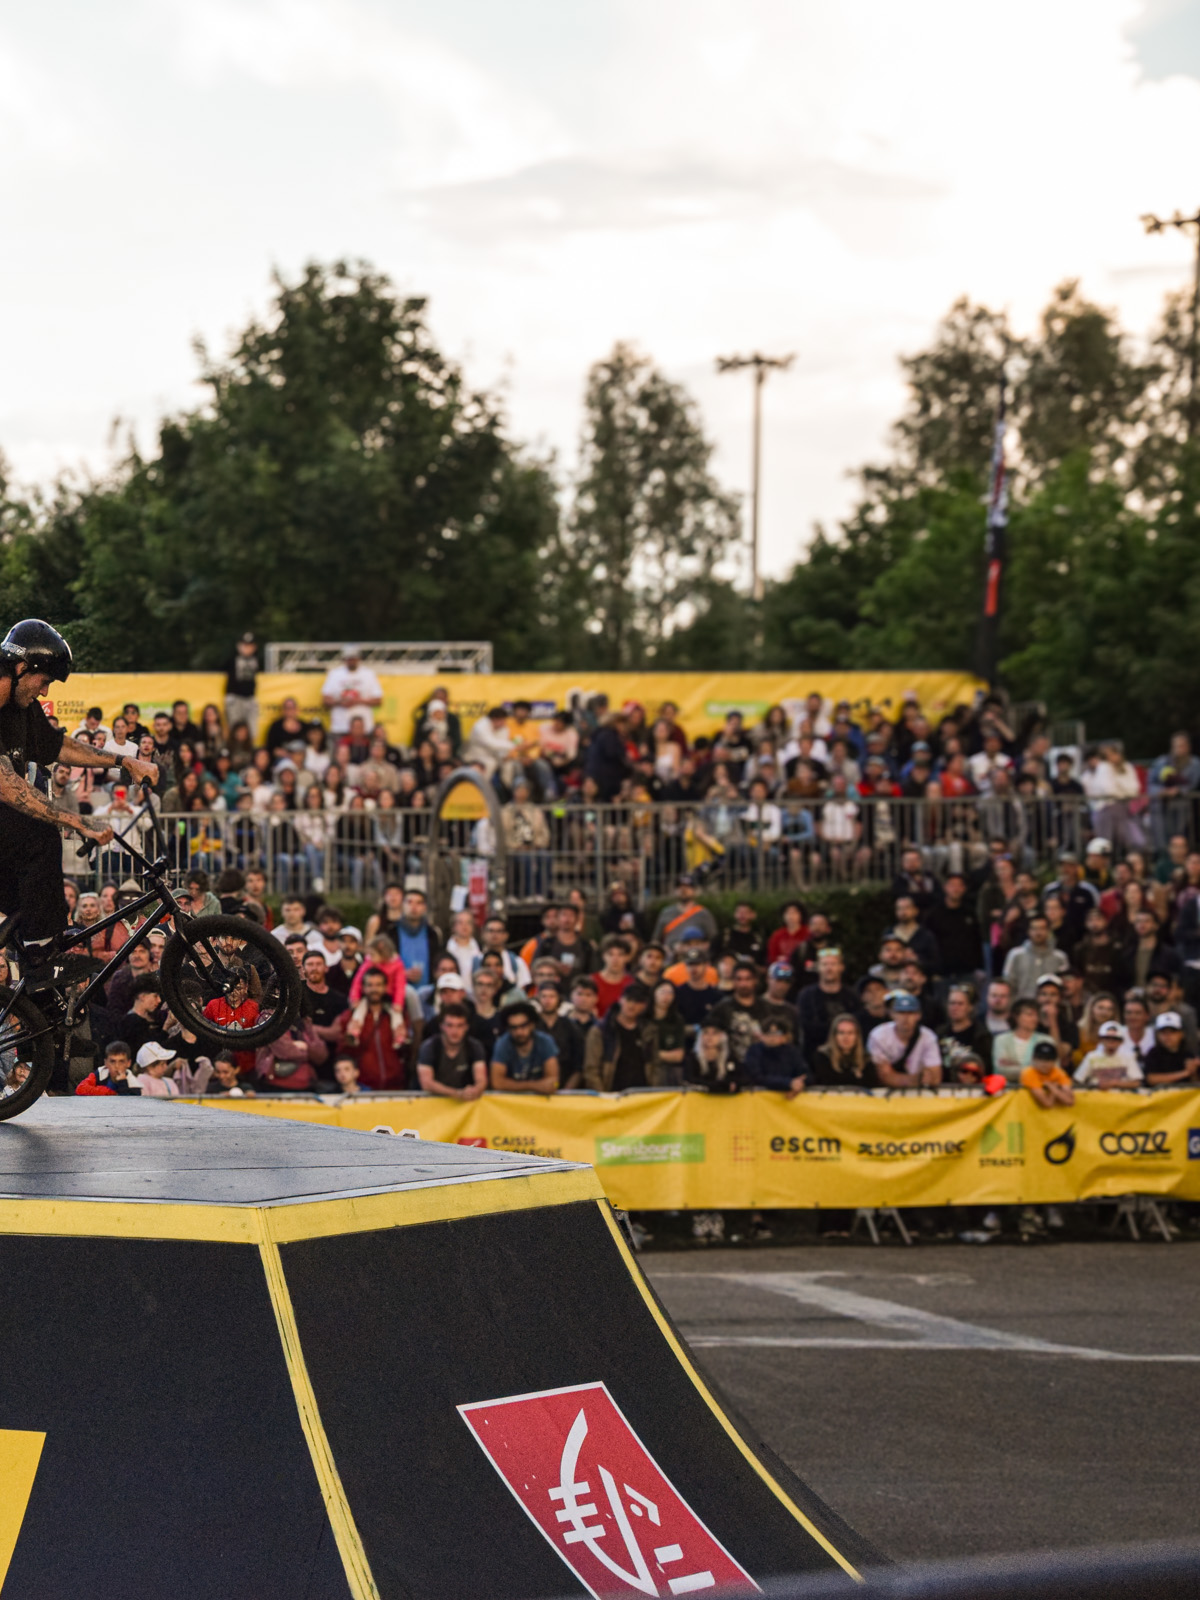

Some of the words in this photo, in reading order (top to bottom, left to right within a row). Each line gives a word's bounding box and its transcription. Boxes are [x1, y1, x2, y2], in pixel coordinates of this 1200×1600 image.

[492, 1135, 536, 1147] CAISSE
[770, 1136, 842, 1153] escm
[875, 1139, 967, 1156] socomec
